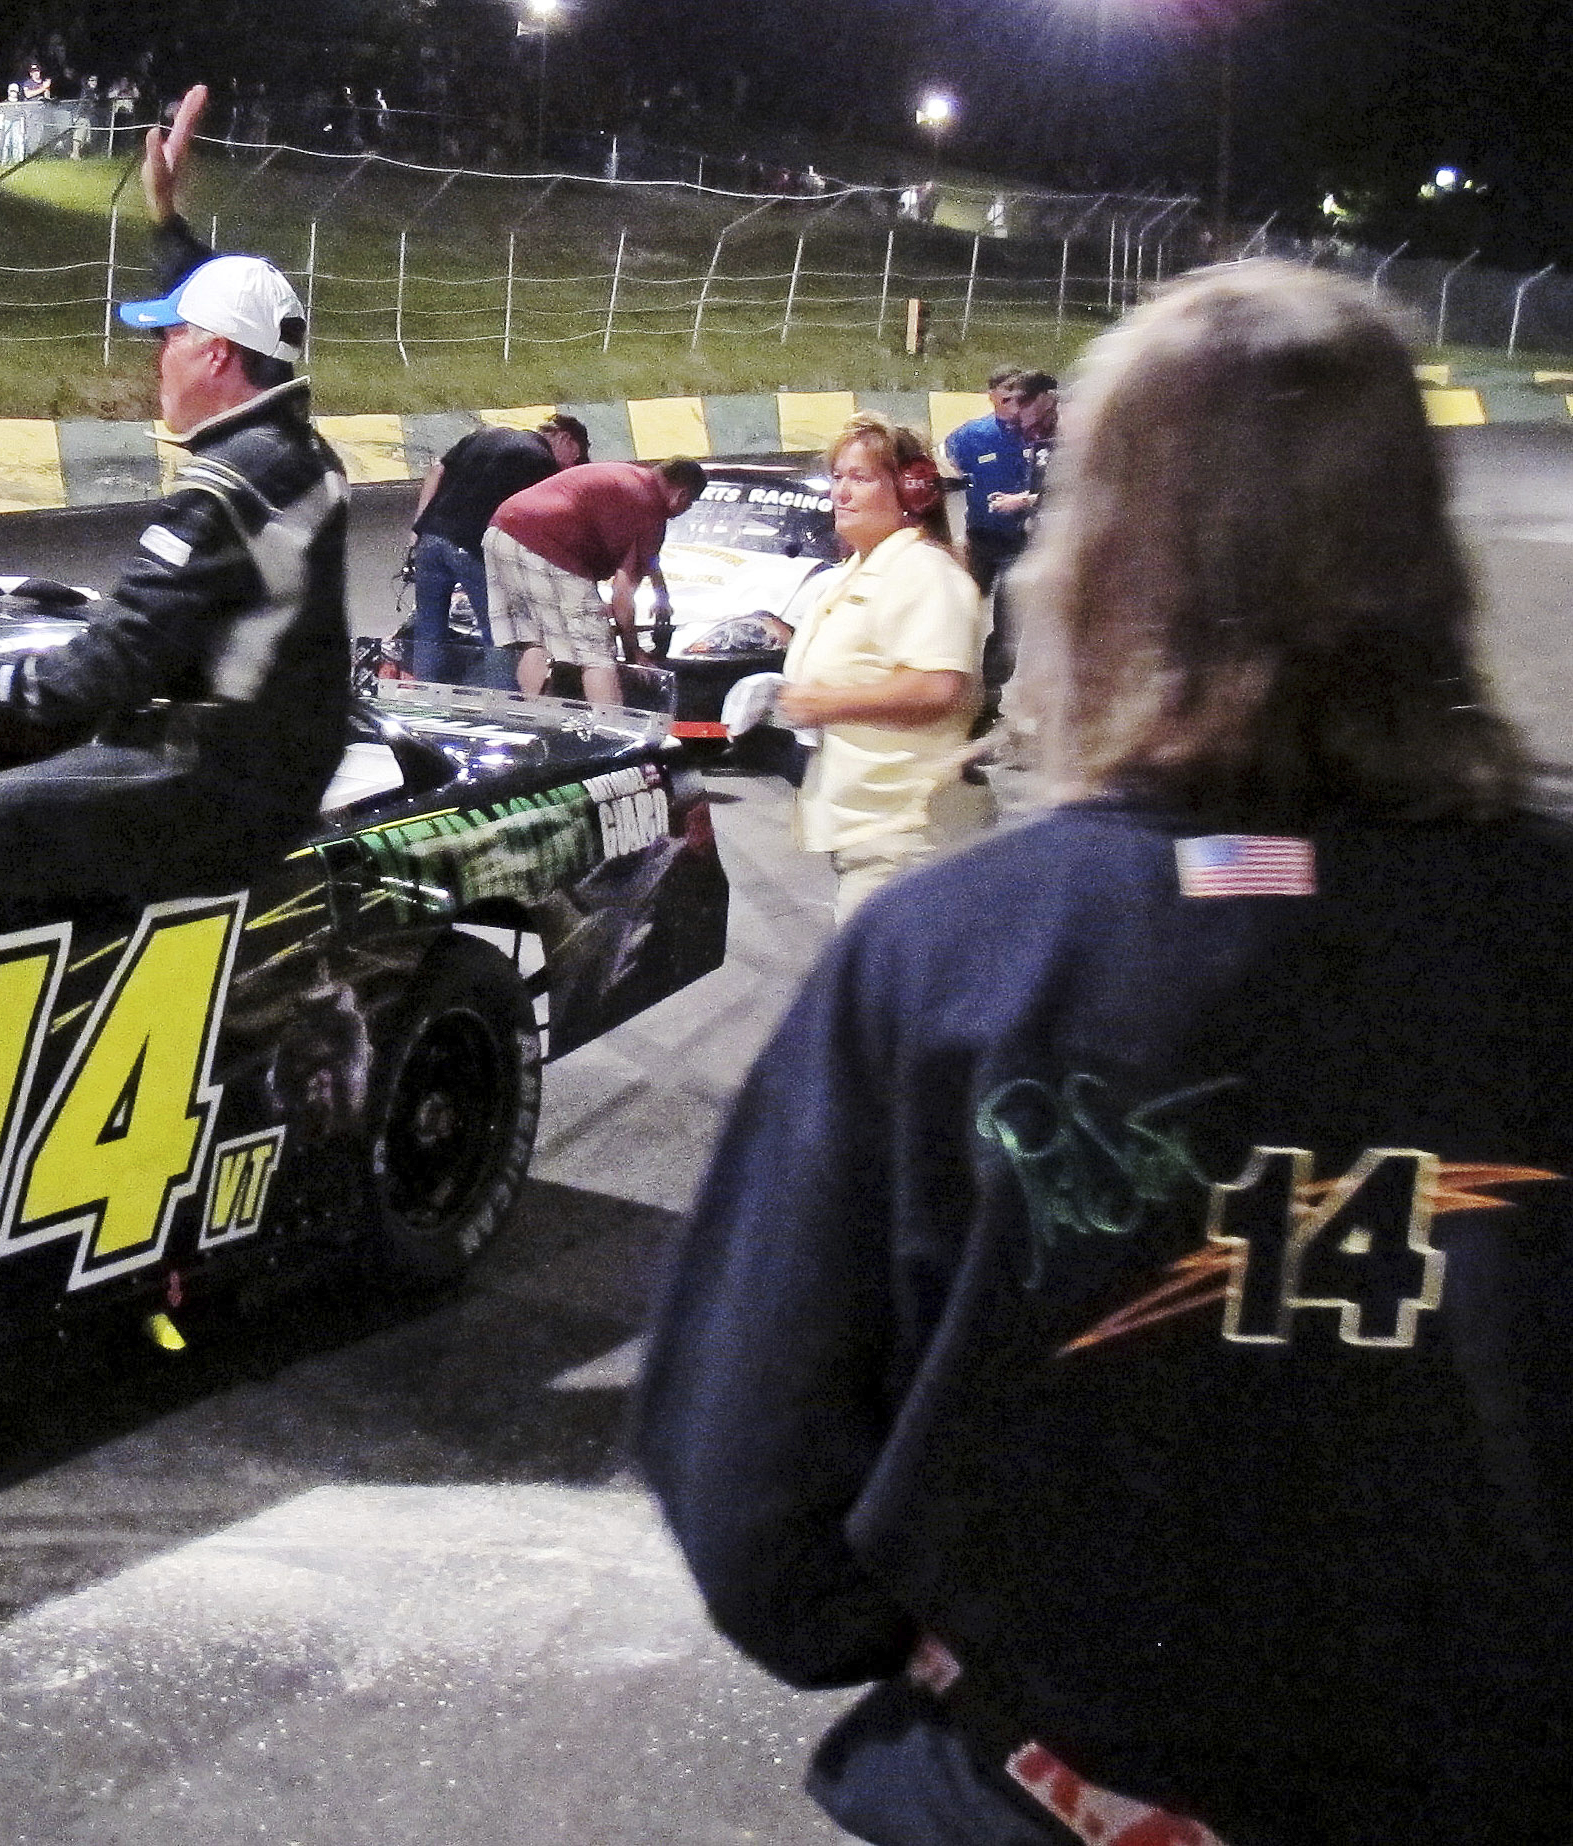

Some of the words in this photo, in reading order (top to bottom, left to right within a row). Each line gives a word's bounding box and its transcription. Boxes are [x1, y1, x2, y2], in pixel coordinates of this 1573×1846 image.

[747, 488, 834, 513] RACING
[199, 1124, 287, 1250] VT
[1202, 1144, 1448, 1348] 14
